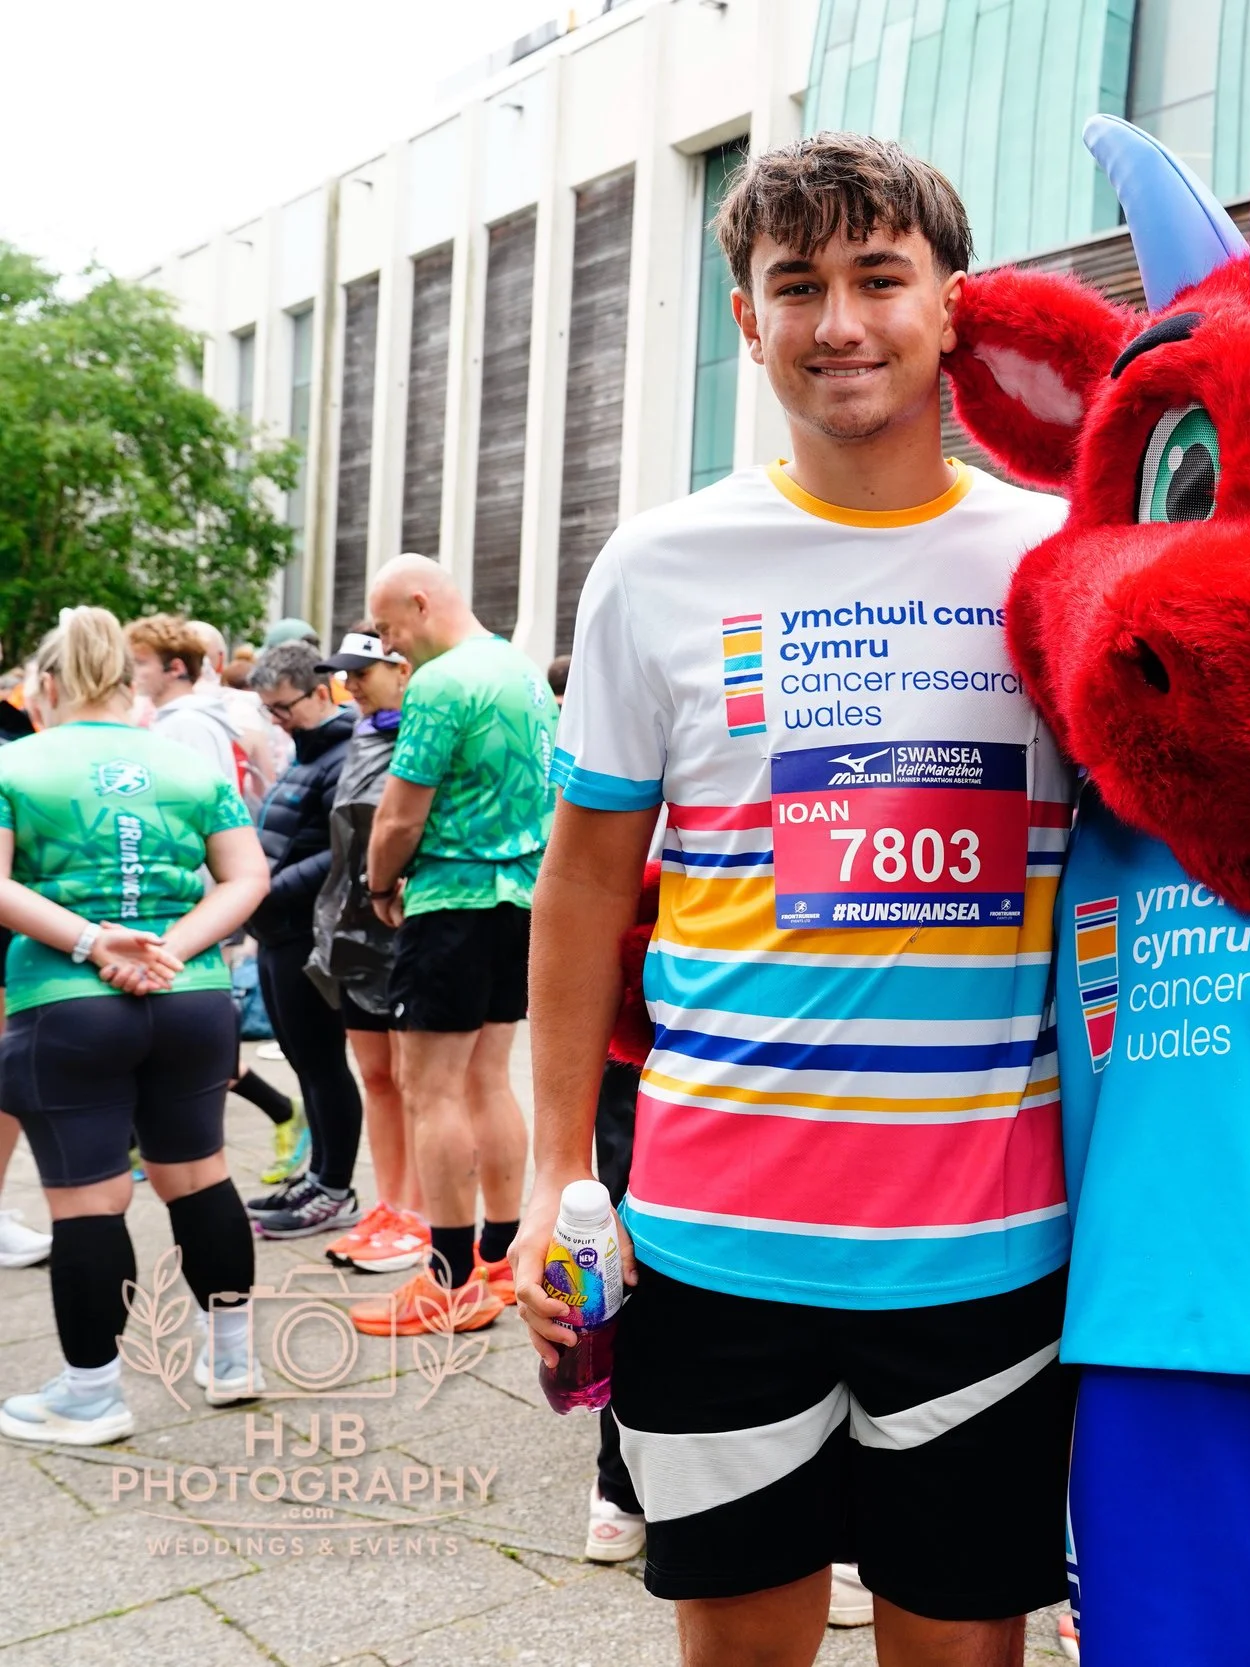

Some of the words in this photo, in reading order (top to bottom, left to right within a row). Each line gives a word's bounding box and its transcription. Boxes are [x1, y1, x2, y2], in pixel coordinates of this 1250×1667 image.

[780, 600, 927, 635] ymchwil
[934, 605, 1006, 627] cans
[779, 638, 889, 666] cymru
[781, 672, 896, 695] cancer
[902, 670, 1023, 694] researc
[784, 700, 882, 729] wales
[897, 747, 982, 764] SWANSEA
[779, 801, 849, 824] IOAN
[830, 827, 981, 883] 7803
[832, 903, 980, 921] #RUNSWANSEA
[1126, 1019, 1231, 1061] wales
[579, 1254, 595, 1263] NEW
[543, 1279, 588, 1307] cozade
